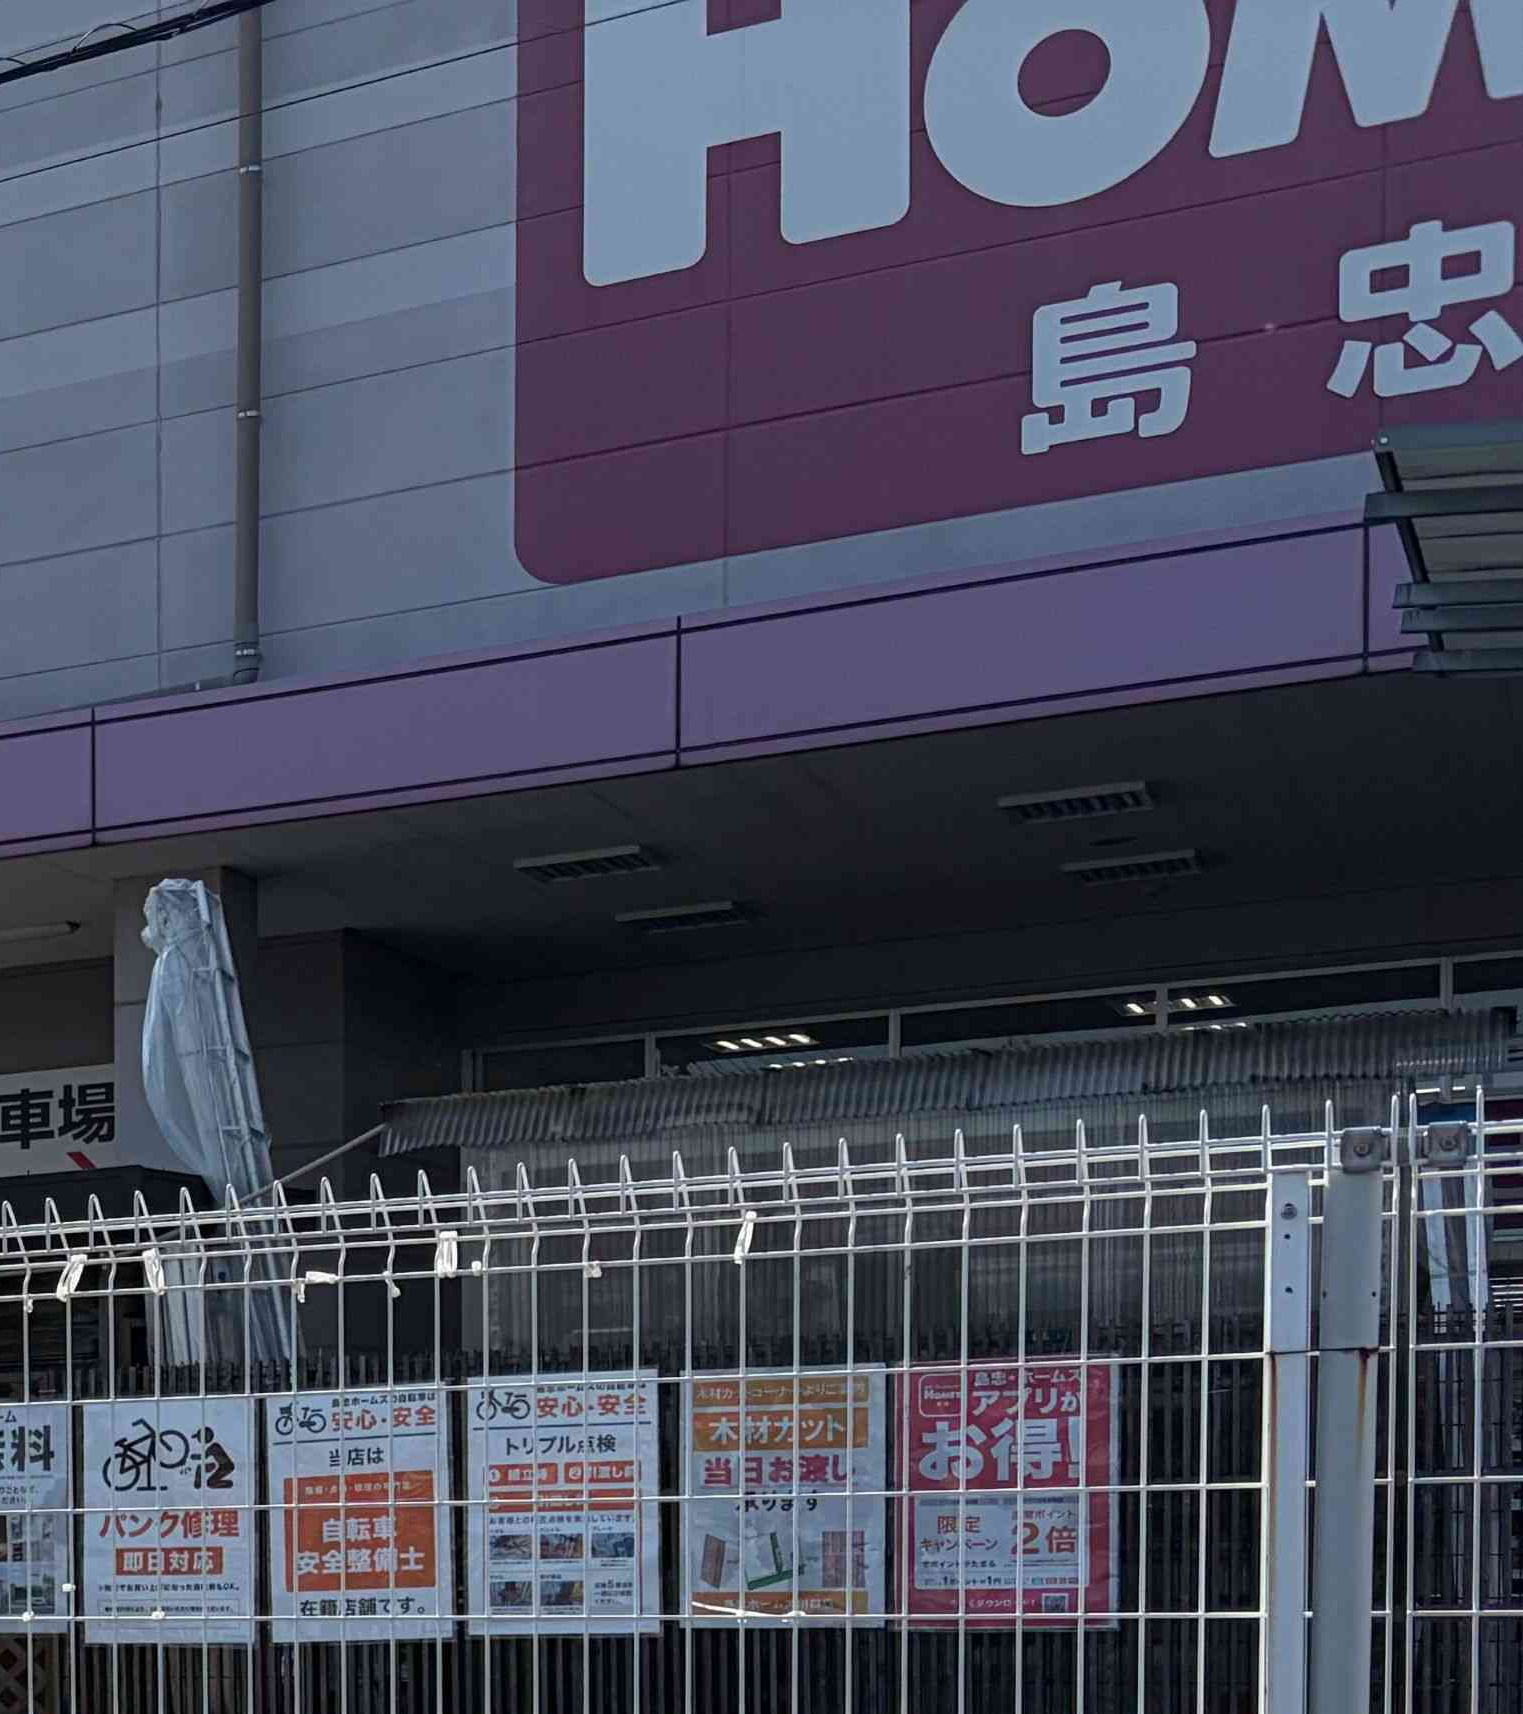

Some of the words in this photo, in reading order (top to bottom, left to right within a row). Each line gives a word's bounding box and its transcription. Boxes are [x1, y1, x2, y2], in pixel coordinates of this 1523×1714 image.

[1021, 219, 1523, 456] 島忠
[331, 1405, 436, 1432] 安心・安全
[537, 1394, 647, 1418] 安心・安全
[708, 1414, 845, 1445] 木材カット
[329, 1447, 385, 1467] 当店は
[704, 1454, 855, 1486] 当日お渡し
[99, 1509, 240, 1539] パンク修理
[322, 1515, 397, 1543] 自転車
[937, 1515, 981, 1534] 限定
[123, 1550, 214, 1573] 即日対応
[297, 1546, 425, 1576] 安全整備士
